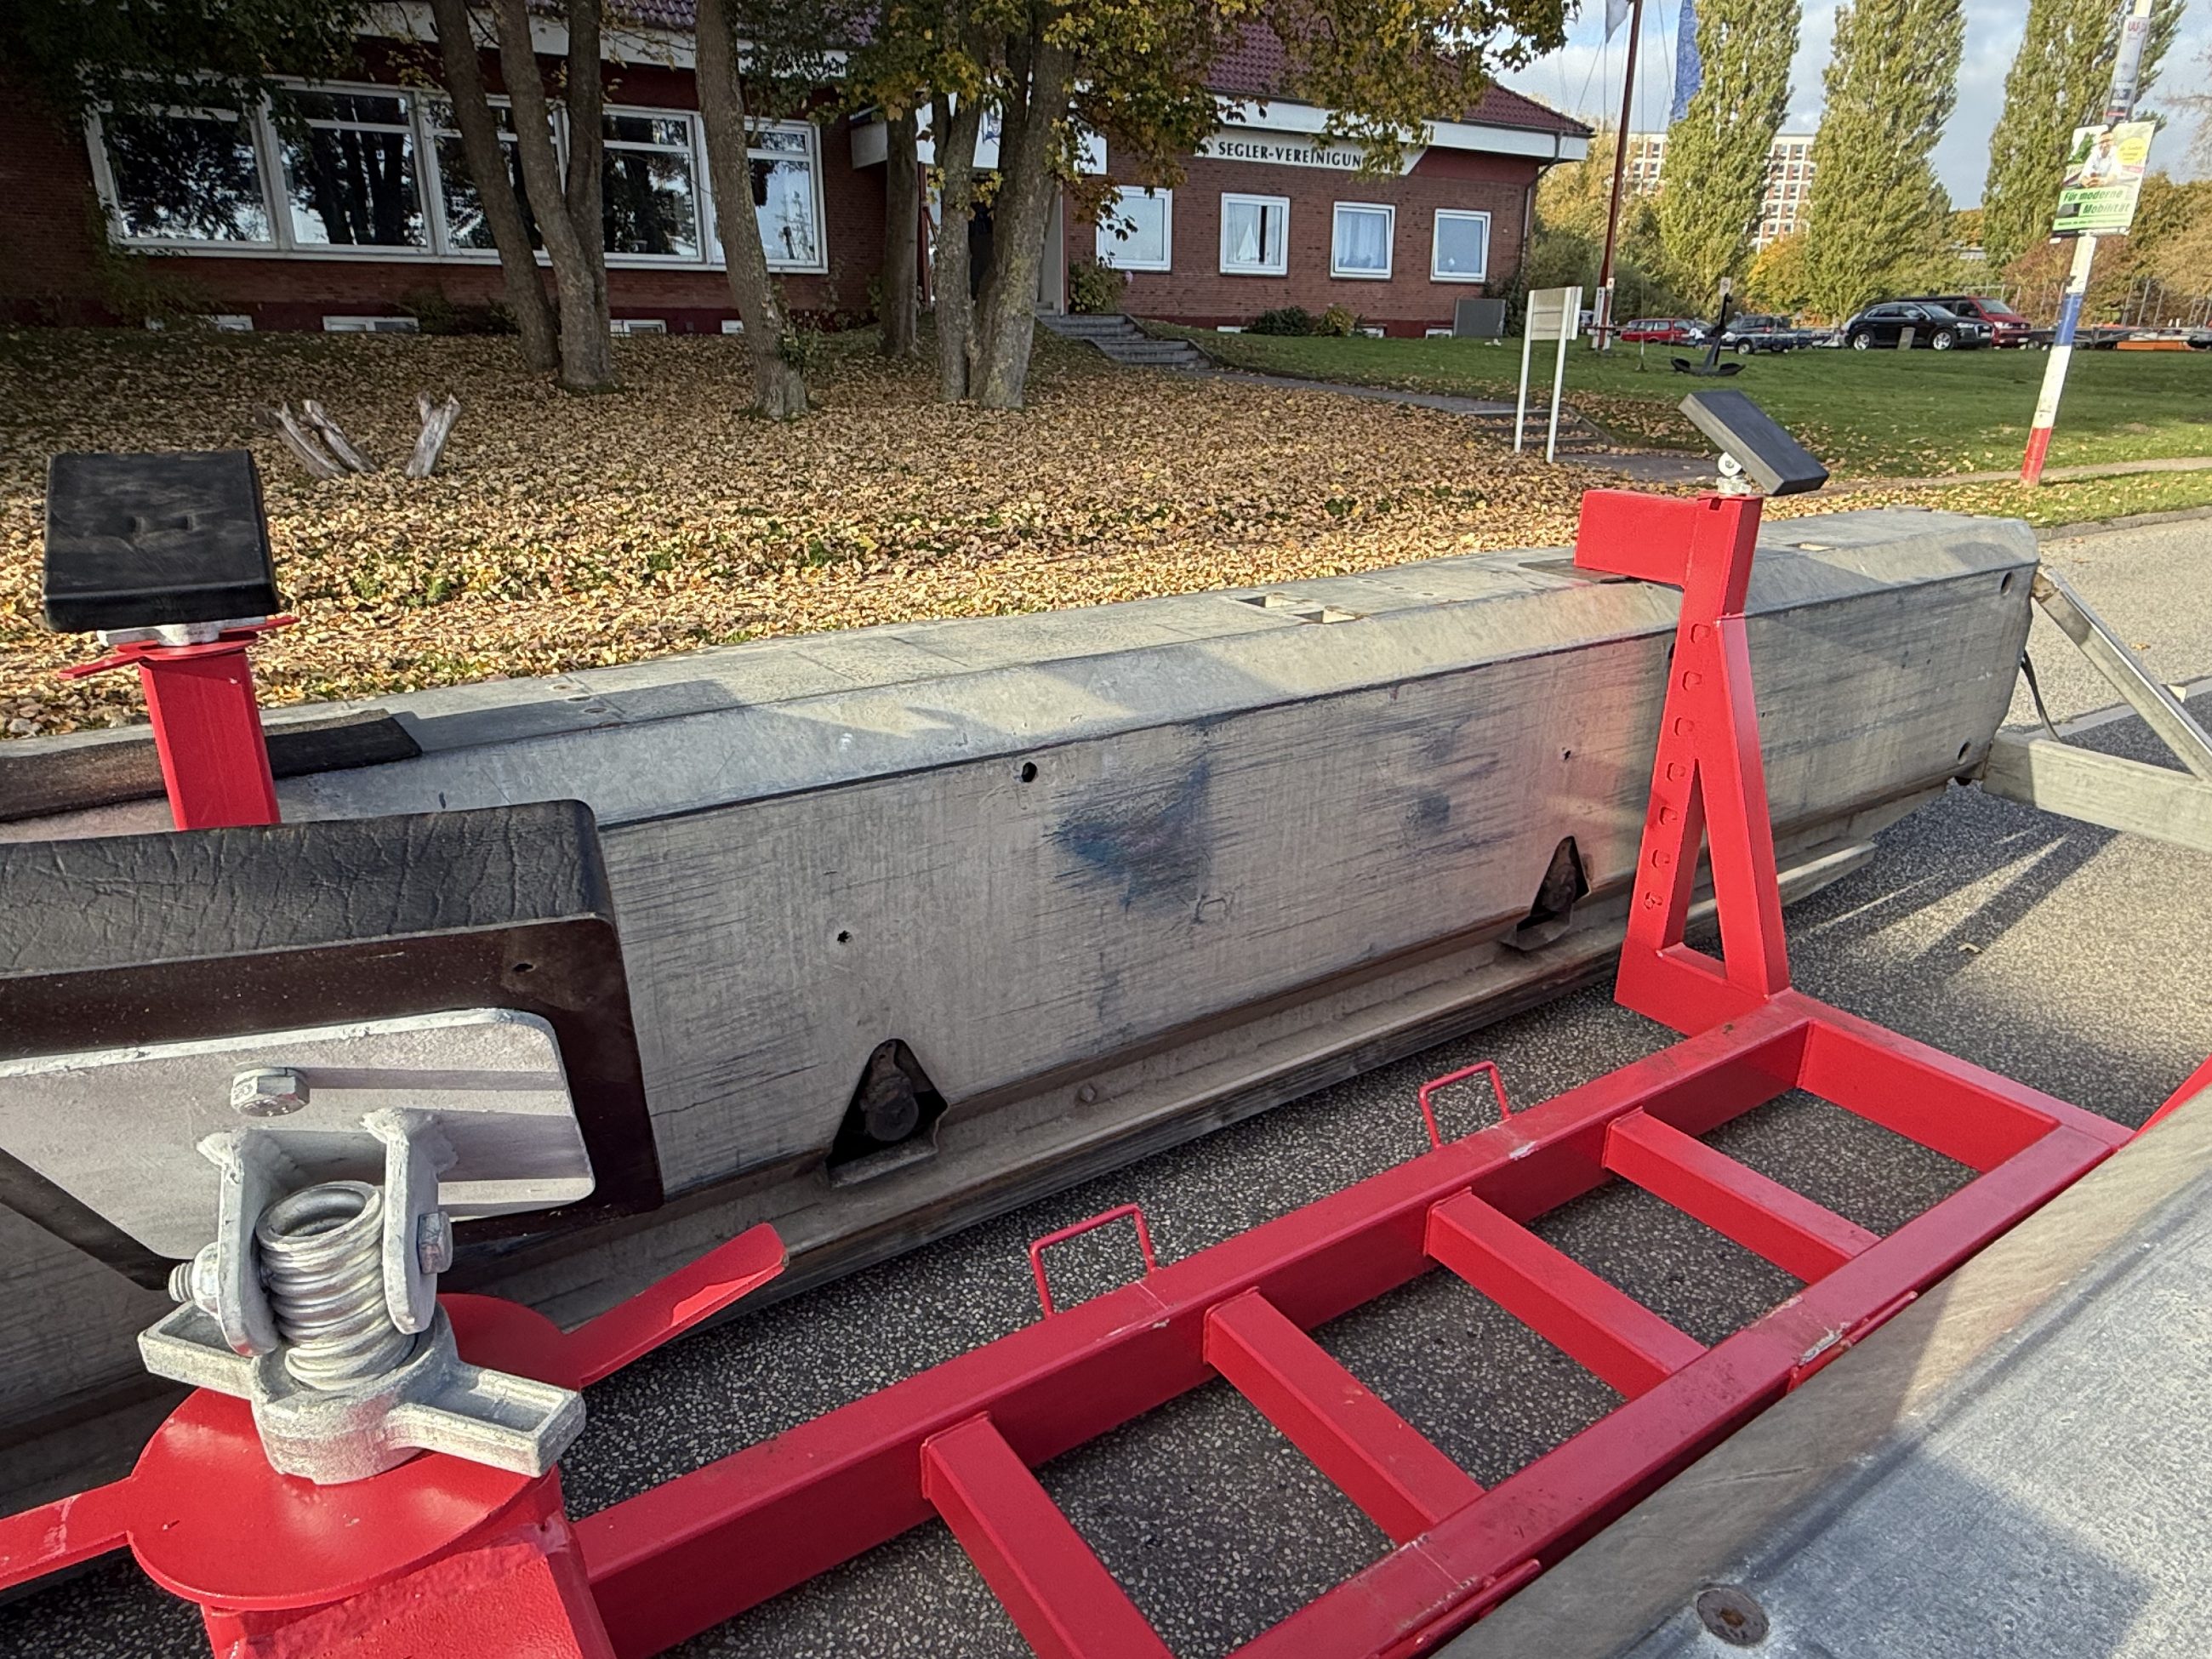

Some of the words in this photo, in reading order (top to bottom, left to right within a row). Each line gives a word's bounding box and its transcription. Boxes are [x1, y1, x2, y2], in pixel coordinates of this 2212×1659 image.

[1218, 141, 1363, 168] SEGLER-VEREINIGUN
[2064, 191, 2078, 202] Für
[2079, 190, 2124, 200] moderne
[2083, 203, 2131, 214] Mobilität
